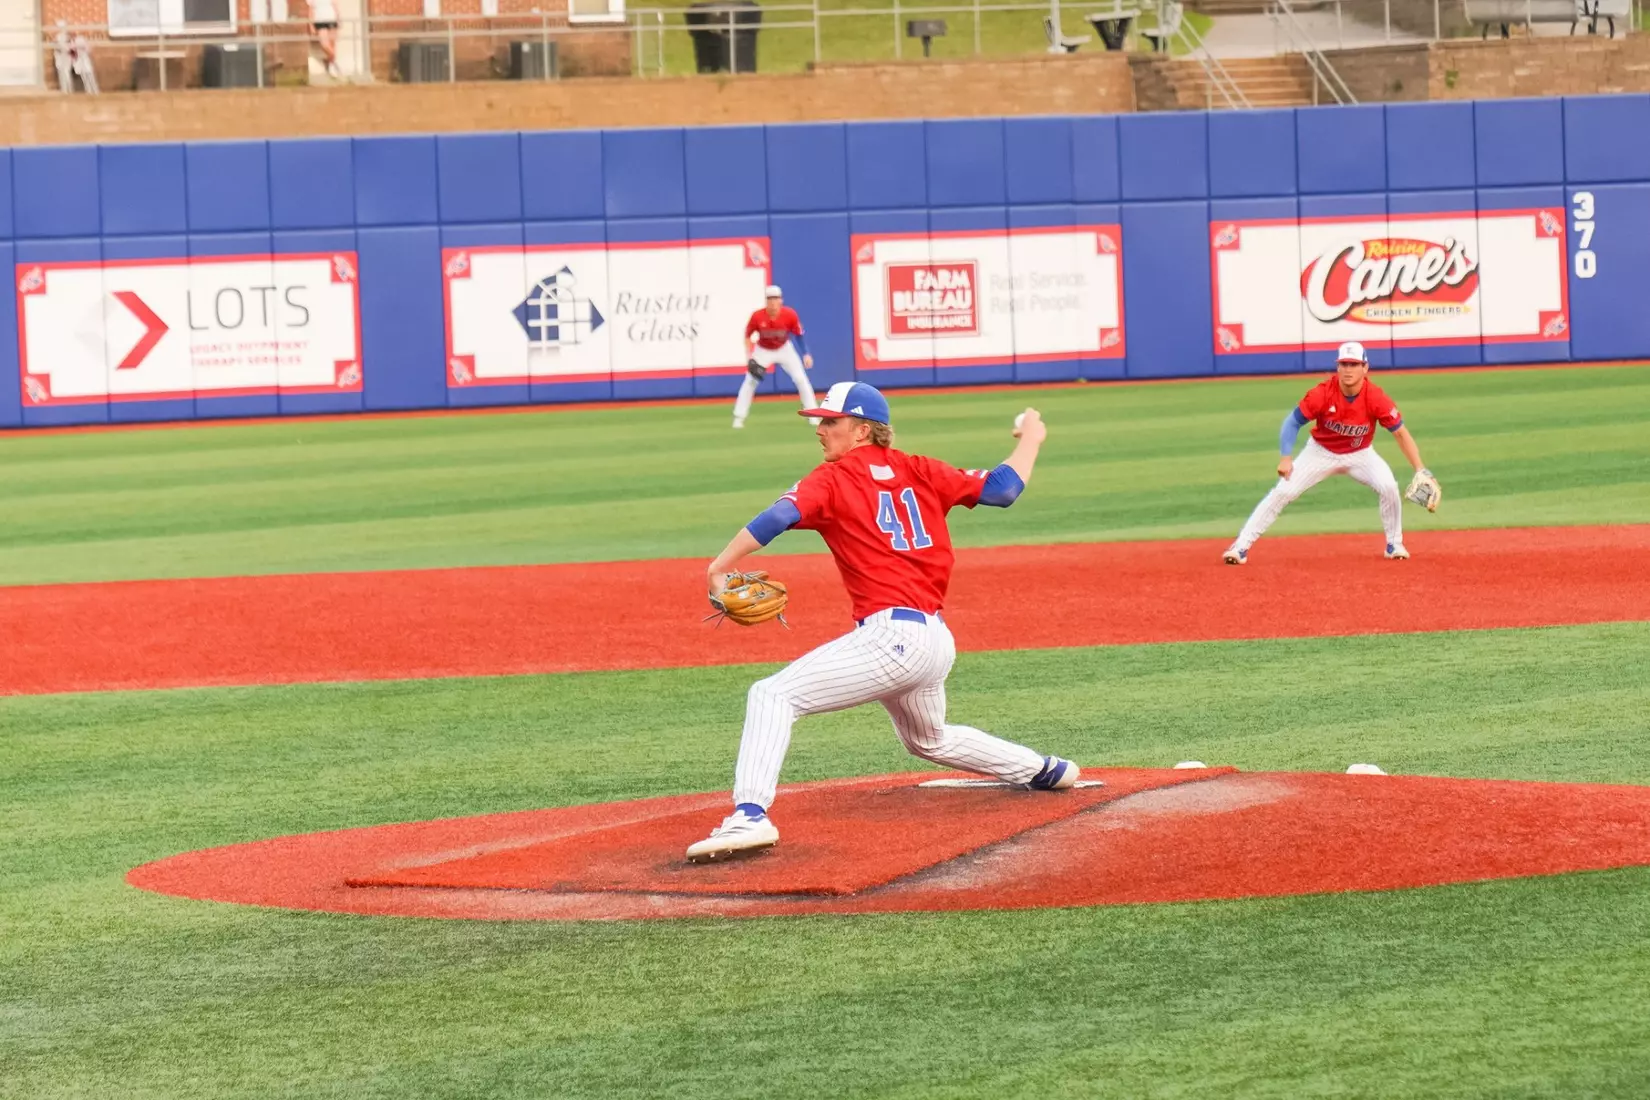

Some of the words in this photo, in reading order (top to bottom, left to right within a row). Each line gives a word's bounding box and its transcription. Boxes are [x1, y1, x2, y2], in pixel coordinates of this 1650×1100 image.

[1573, 191, 1597, 279] 370
[1366, 240, 1426, 258] Raising
[914, 268, 971, 290] FARM
[1305, 236, 1480, 322] Cane's
[186, 284, 310, 331] LOTS
[615, 291, 710, 315] Ruston
[892, 288, 973, 312] BUREAU
[626, 317, 701, 342] Glass
[876, 488, 933, 551] 41
